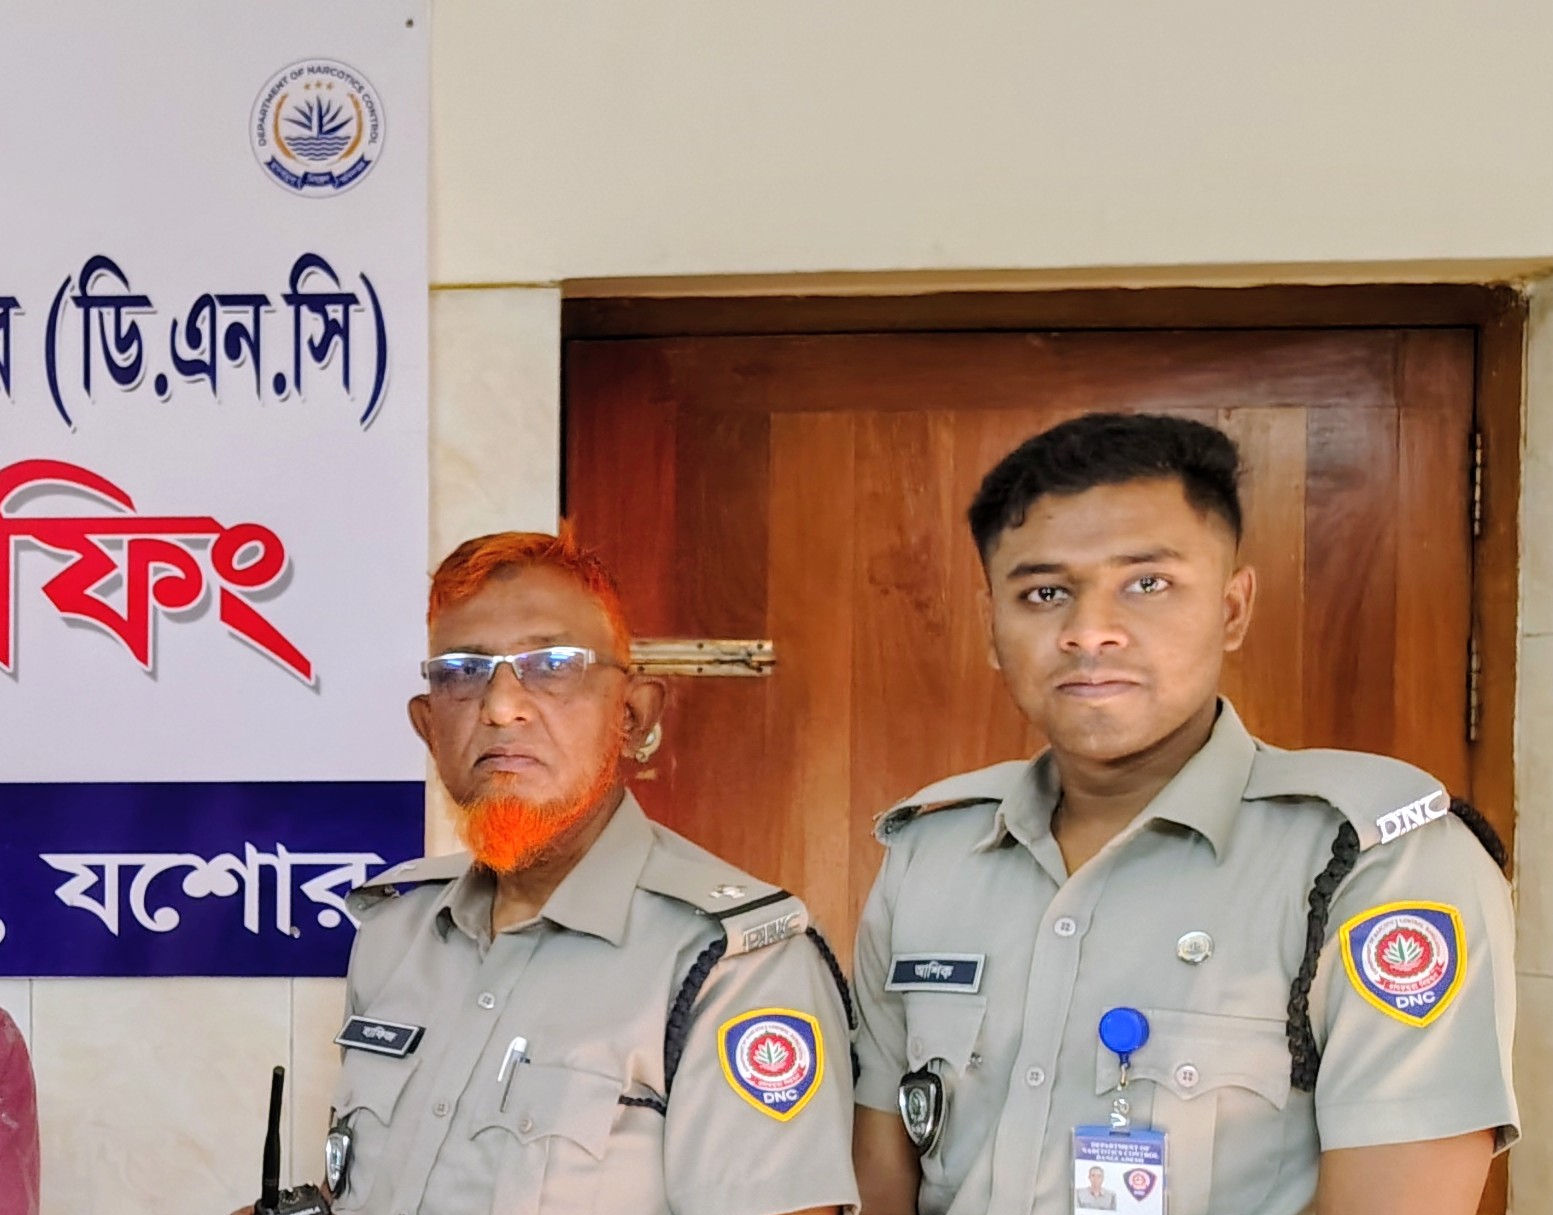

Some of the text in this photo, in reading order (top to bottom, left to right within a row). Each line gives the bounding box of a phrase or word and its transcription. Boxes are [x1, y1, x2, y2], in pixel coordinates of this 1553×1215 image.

[257, 65, 379, 147] DEPARTMENT OF NARCOTICS CONTROL
[44, 252, 388, 430] (ডি.এন.সি)
[1395, 991, 1436, 1009] DNC
[762, 1089, 798, 1104] DNC
